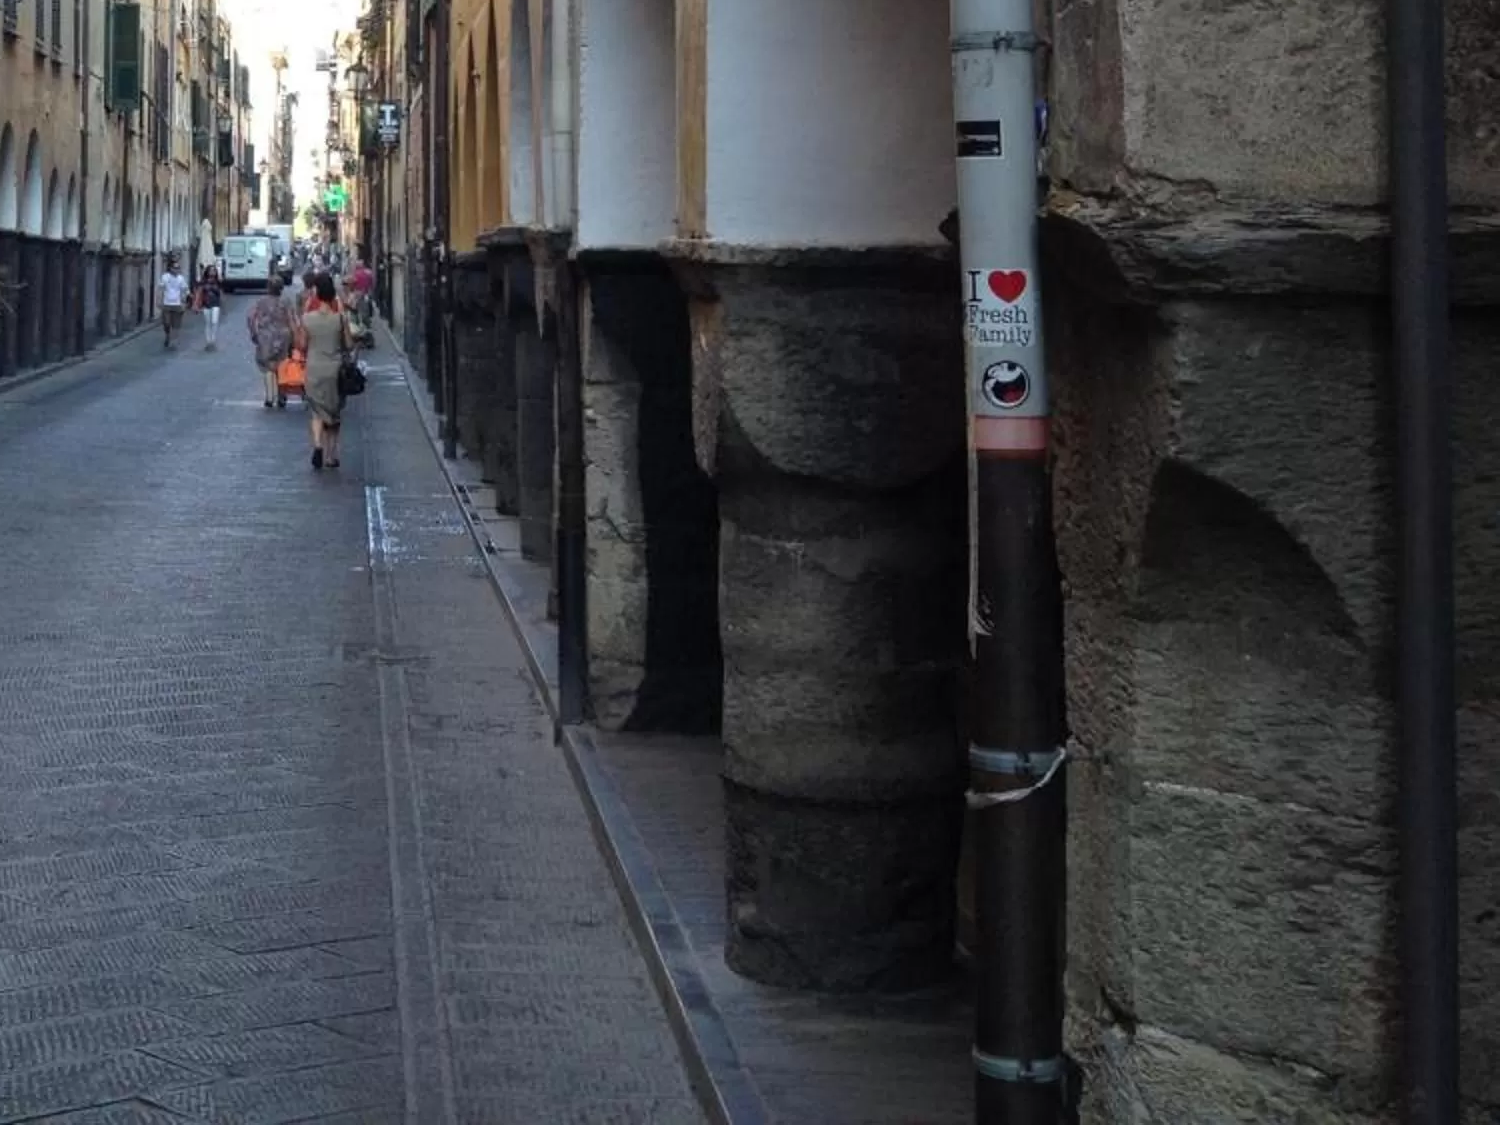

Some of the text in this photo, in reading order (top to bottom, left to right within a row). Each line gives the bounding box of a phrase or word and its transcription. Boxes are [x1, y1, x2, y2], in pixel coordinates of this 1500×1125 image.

[967, 271, 982, 302] I
[968, 304, 1028, 324] Fresh
[968, 325, 1031, 347] Family
